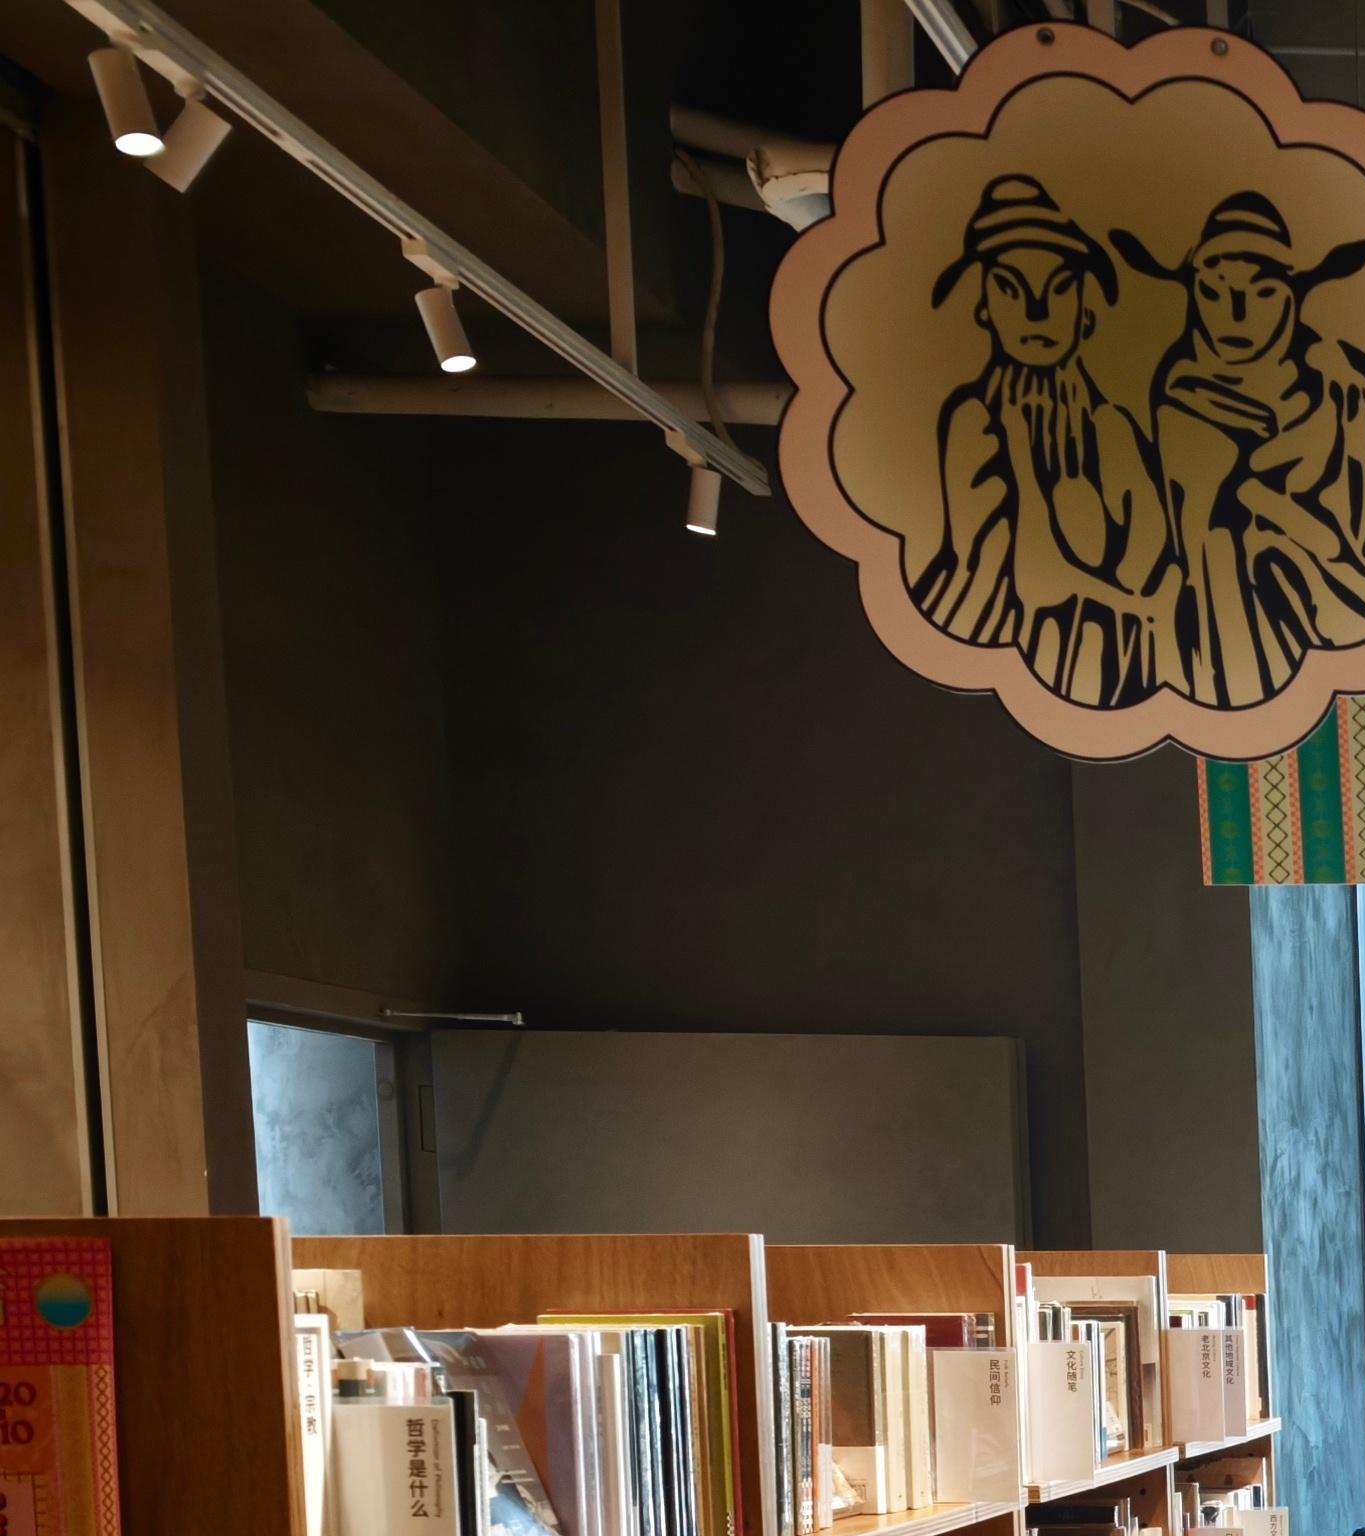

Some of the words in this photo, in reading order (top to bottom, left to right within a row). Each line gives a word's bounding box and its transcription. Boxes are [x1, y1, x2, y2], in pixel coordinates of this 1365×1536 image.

[1066, 1350, 1078, 1392] 文化随笔
[1200, 1334, 1212, 1378] 老北京文化
[989, 1359, 1002, 1405] 民间信仰
[405, 1417, 430, 1519] 哲学是什么
